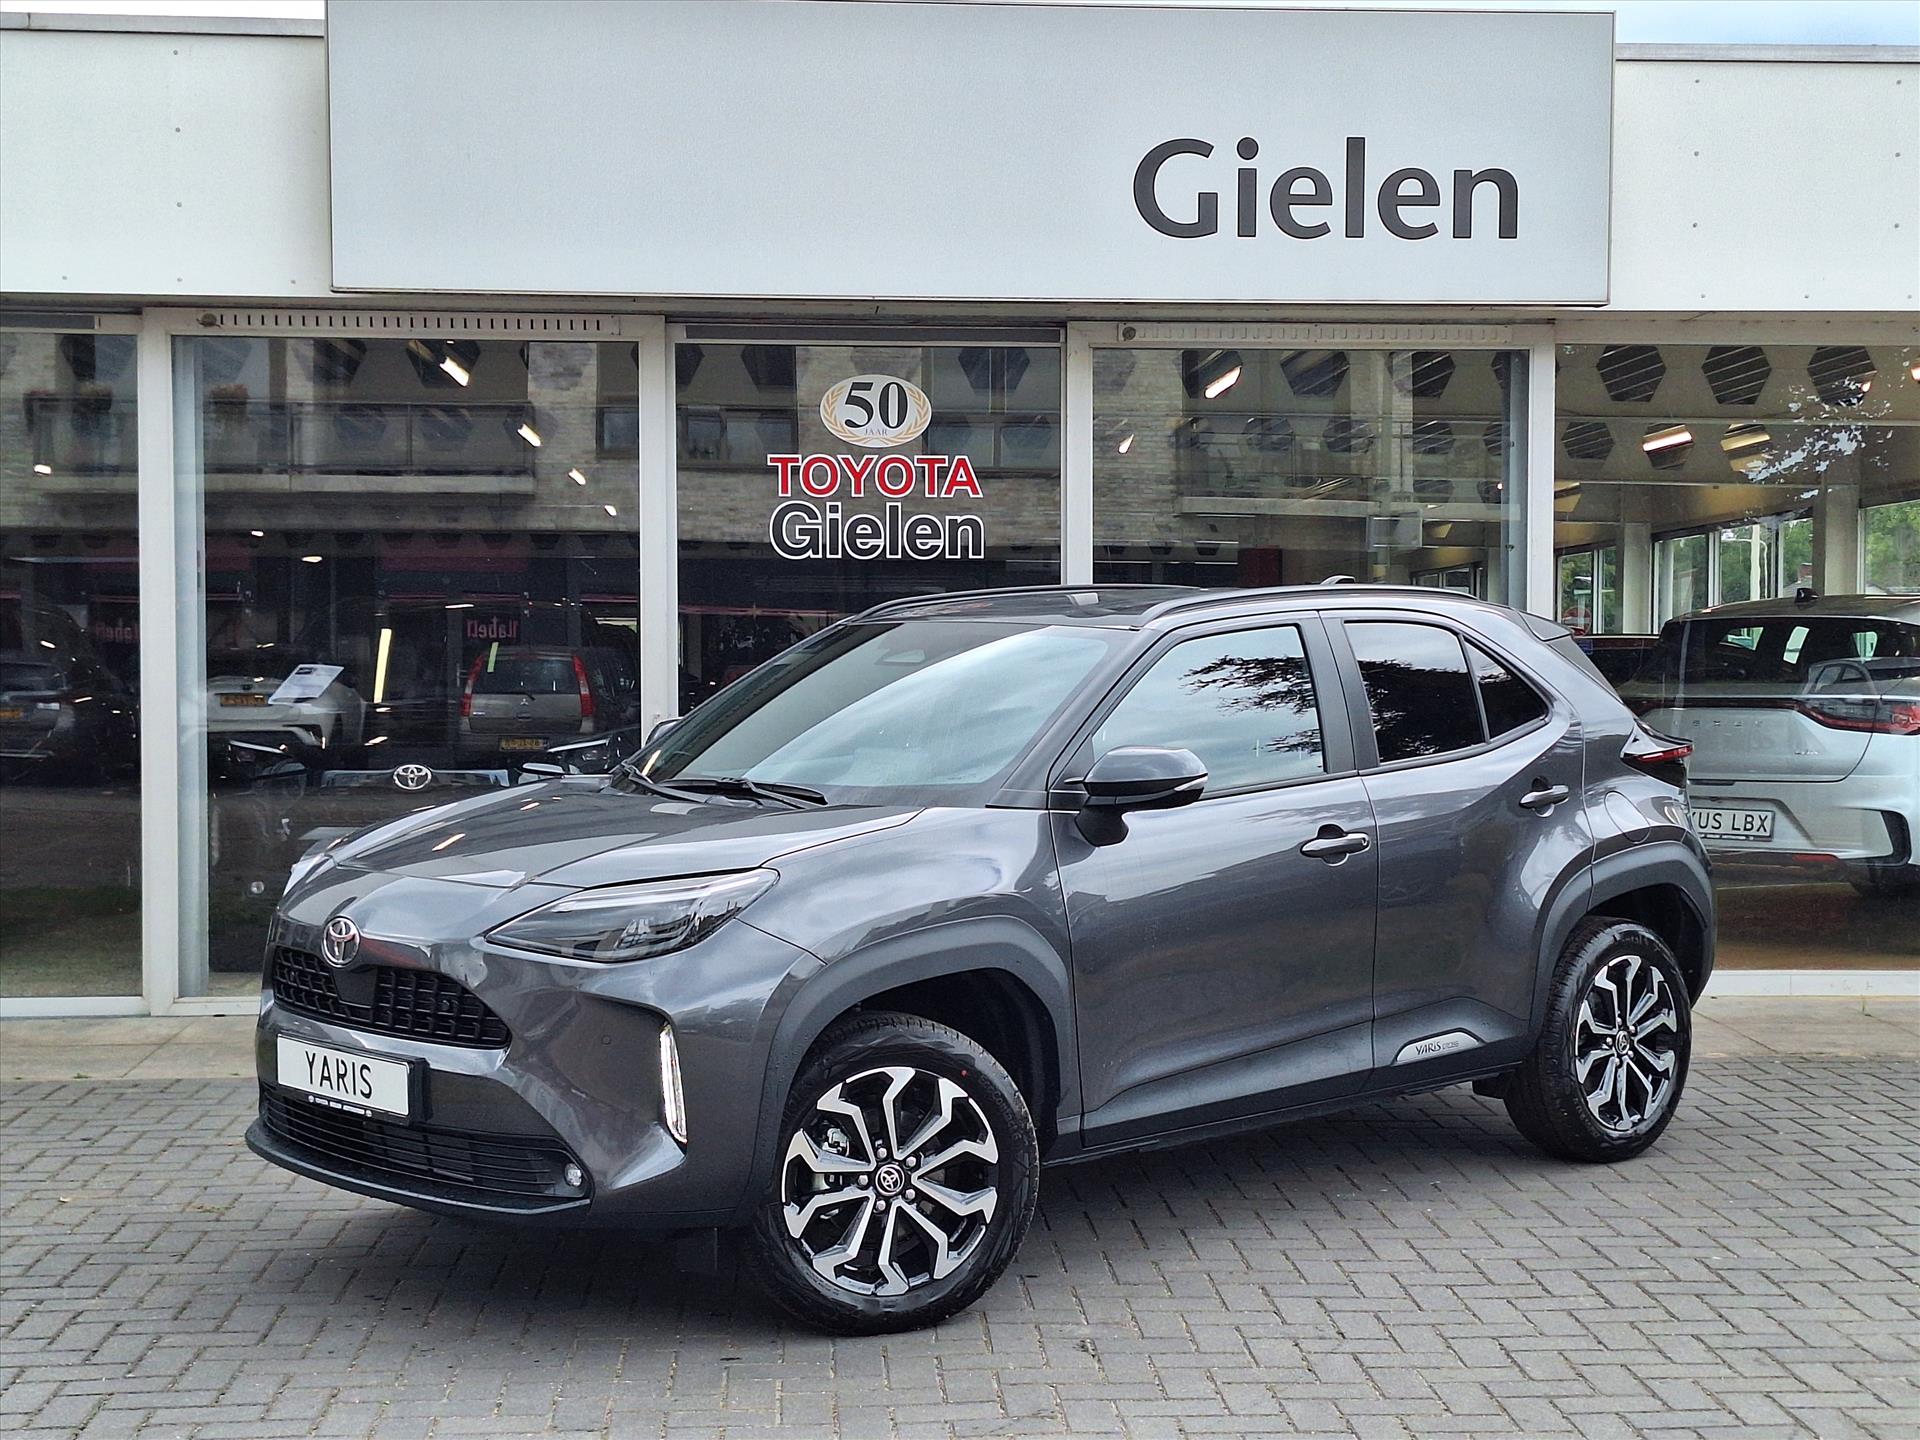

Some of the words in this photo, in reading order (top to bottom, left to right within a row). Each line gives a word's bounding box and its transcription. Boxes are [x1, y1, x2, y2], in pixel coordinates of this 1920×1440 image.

[1133, 136, 1519, 239] Gielen
[844, 382, 908, 429] 50
[864, 428, 888, 437] JAAR
[767, 453, 983, 498] TOYOTA
[769, 500, 985, 560] Gielen
[1692, 811, 1723, 830] US
[1731, 813, 1768, 832] LBX
[1415, 1042, 1442, 1055] YARIS
[305, 1051, 372, 1099] YARIS
